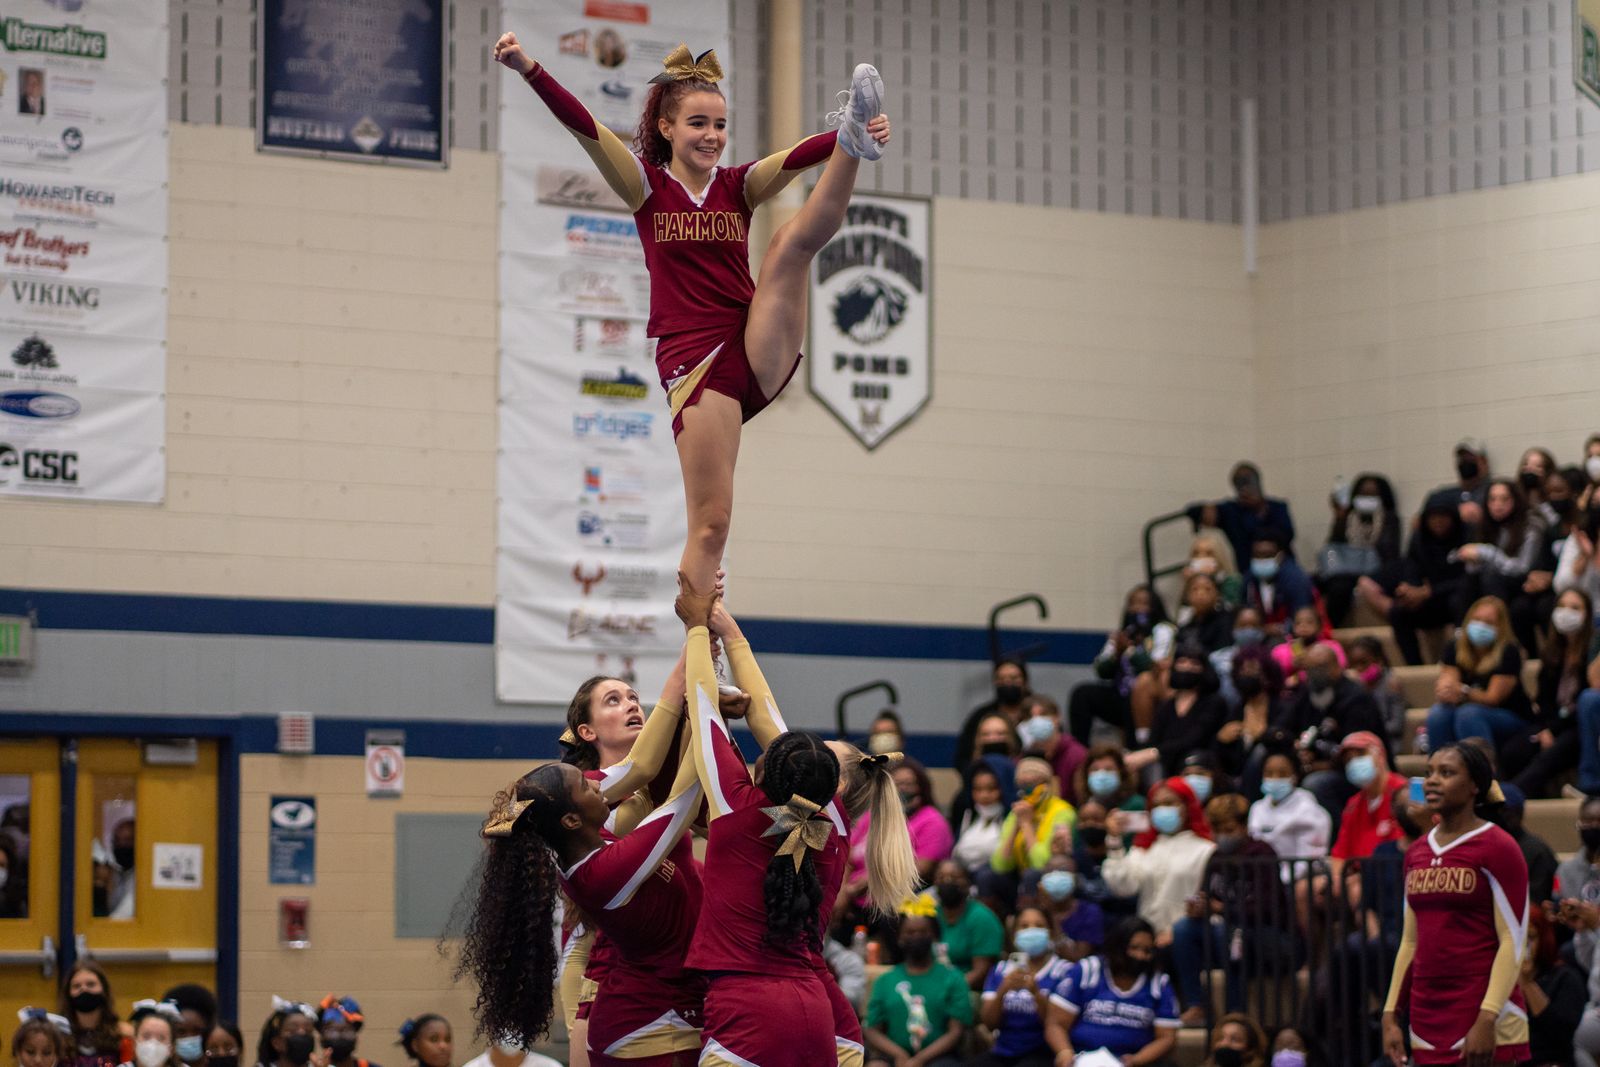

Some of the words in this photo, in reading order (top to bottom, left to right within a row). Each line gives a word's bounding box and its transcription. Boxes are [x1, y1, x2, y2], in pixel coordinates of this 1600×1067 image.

[0, 17, 105, 57] lternative
[11, 279, 100, 310] VIKING
[573, 412, 653, 440] bridges
[23, 450, 78, 482] CSC
[1407, 866, 1477, 895] AMMOND
